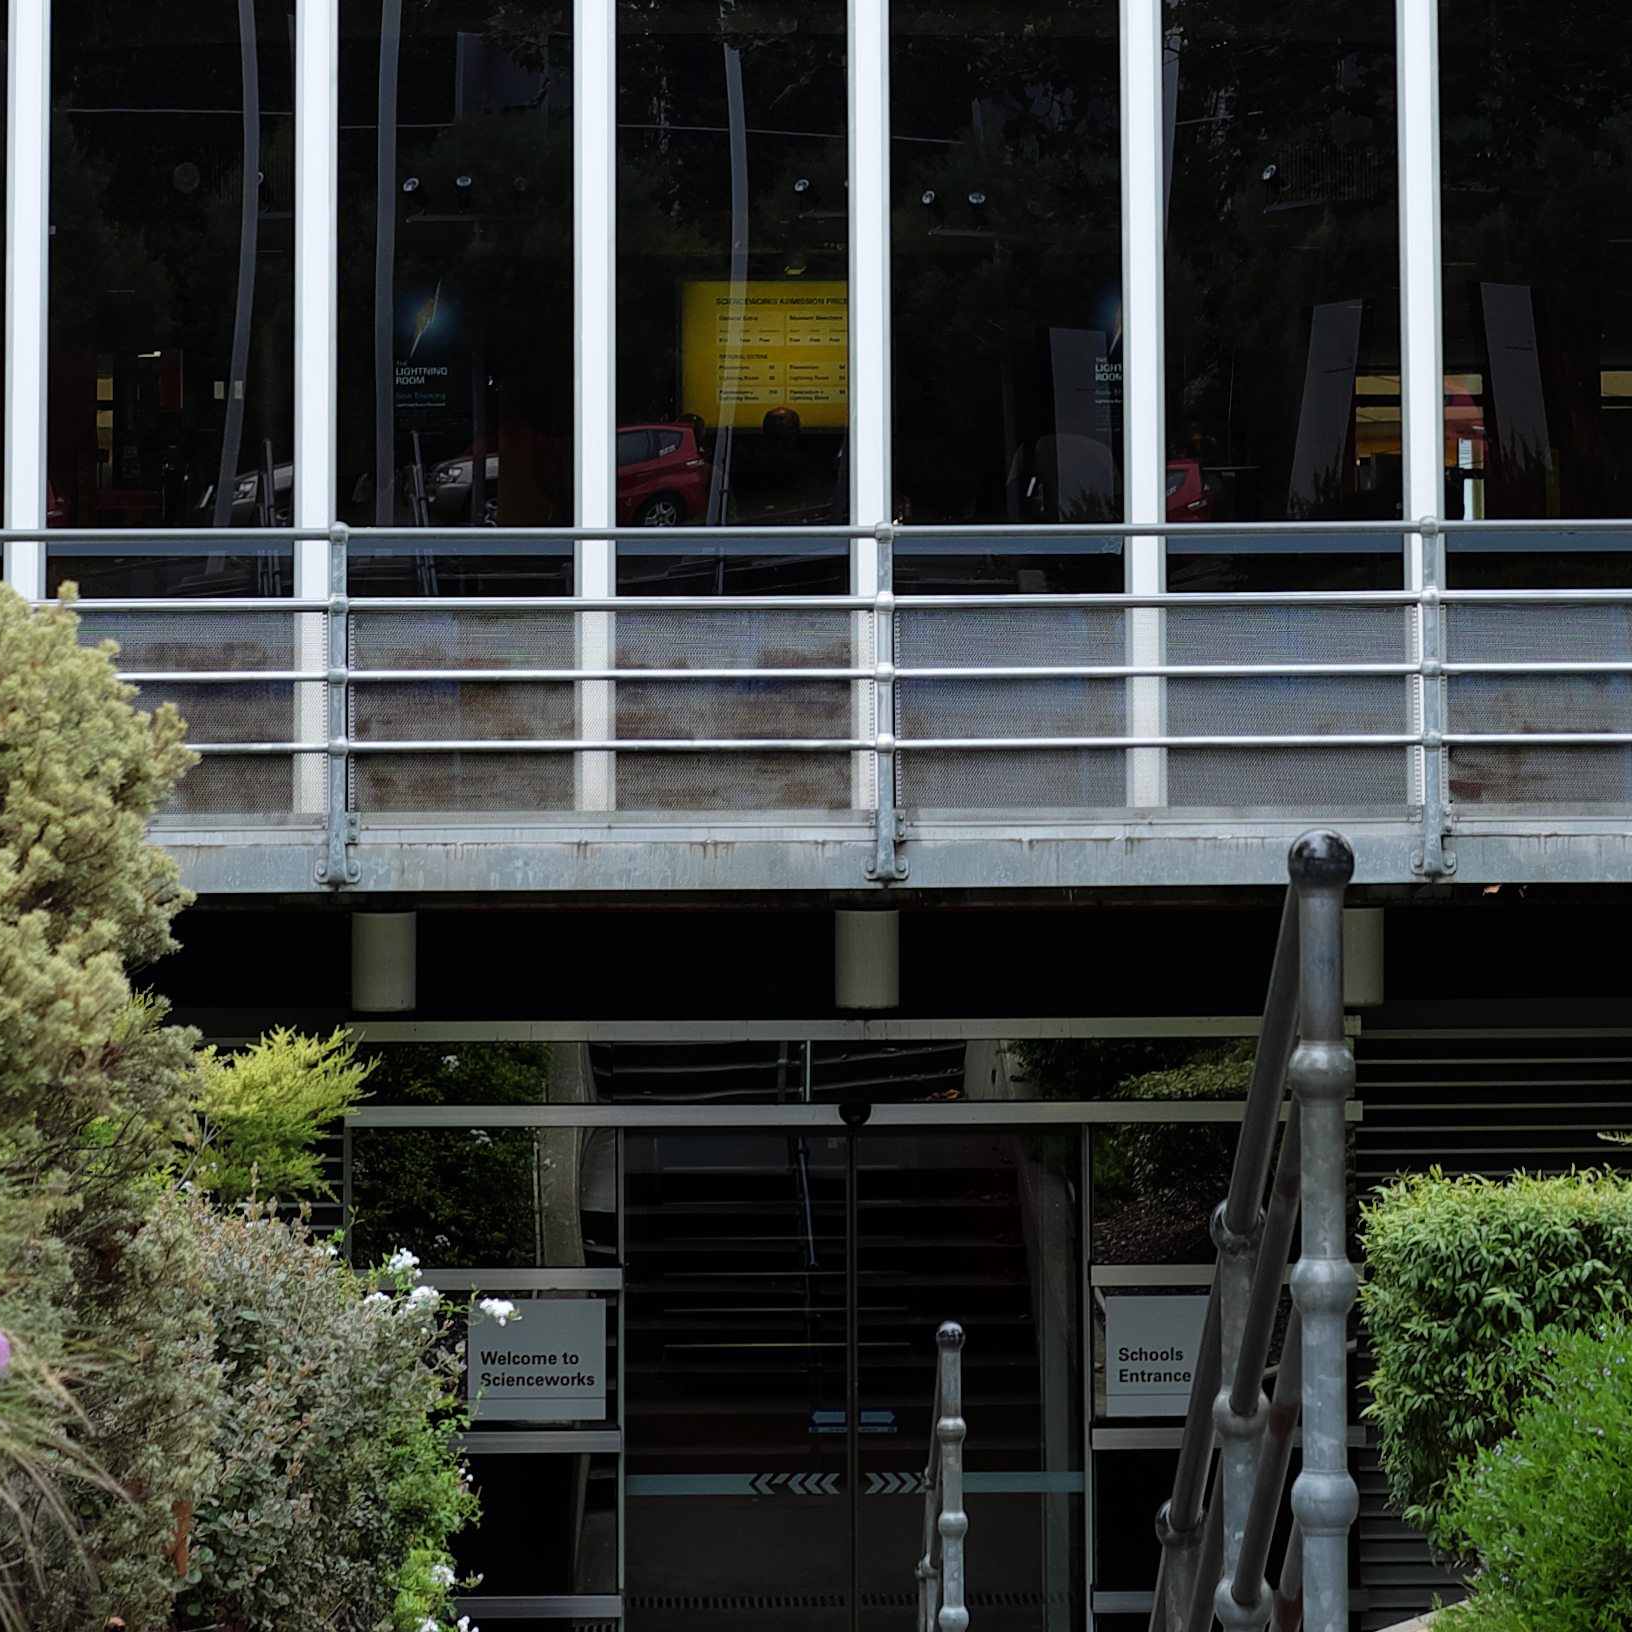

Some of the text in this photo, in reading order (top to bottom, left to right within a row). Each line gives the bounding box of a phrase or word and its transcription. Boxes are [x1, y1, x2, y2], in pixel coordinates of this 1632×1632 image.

[395, 367, 448, 376] LIGHTNING
[395, 376, 425, 385] ROOM
[480, 1351, 579, 1365] Welcome to
[1118, 1347, 1183, 1361] Schools
[480, 1371, 595, 1387] Scienceworks
[1119, 1369, 1191, 1383] Entrance
